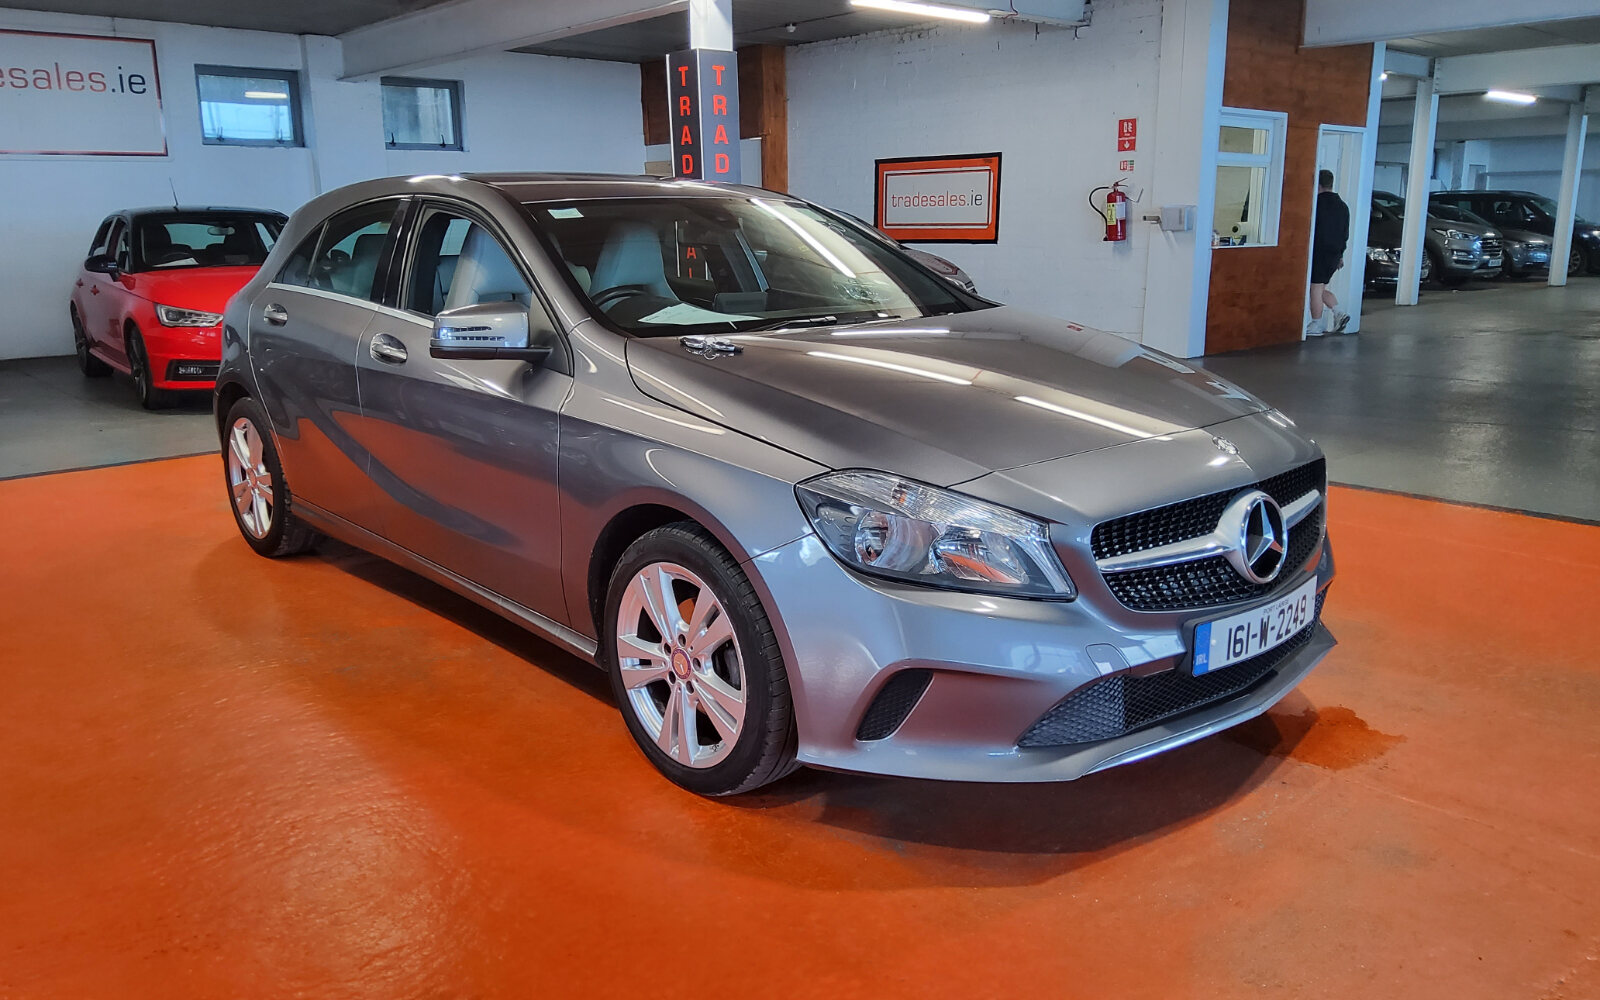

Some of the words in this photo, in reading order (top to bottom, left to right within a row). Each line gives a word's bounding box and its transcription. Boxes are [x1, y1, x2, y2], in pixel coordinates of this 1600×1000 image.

[0, 62, 147, 94] sales.ie
[891, 189, 983, 208] tradesales.ie
[1226, 594, 1307, 661] 161-W-2249
[1195, 653, 1208, 666] IRL
